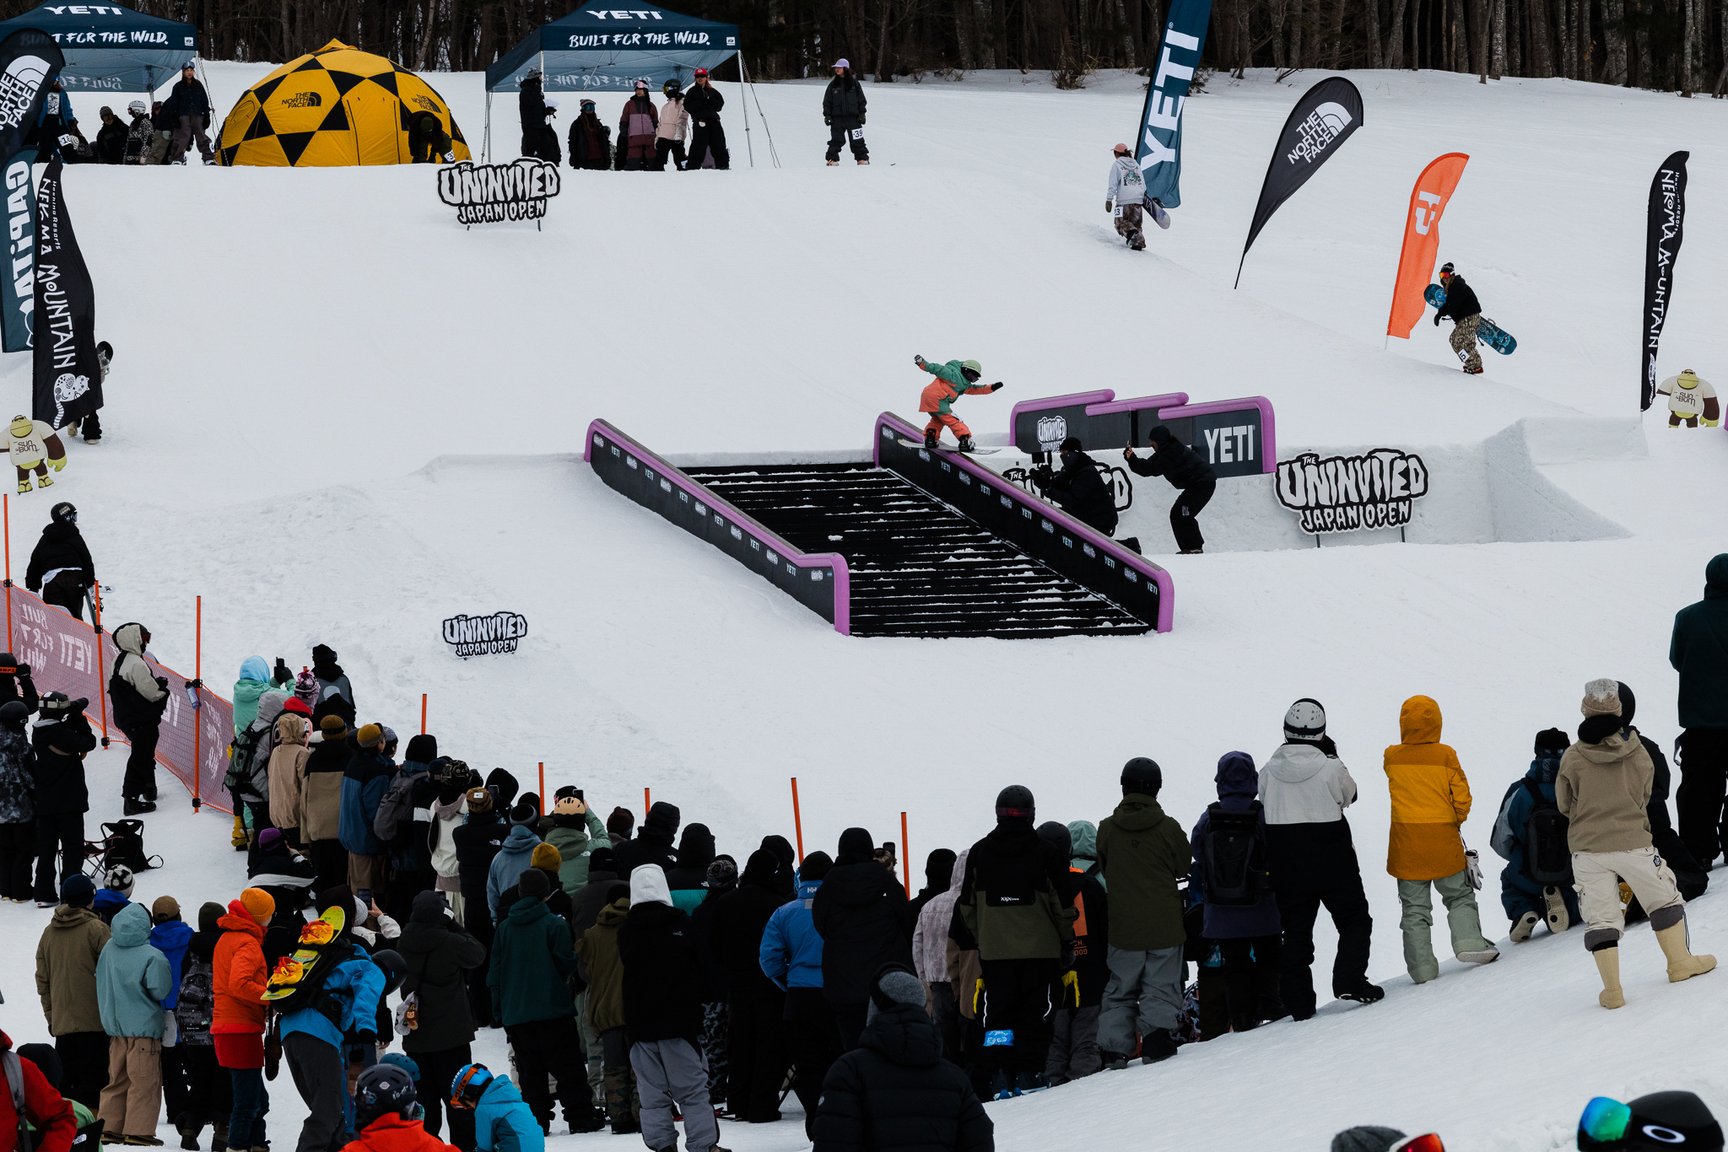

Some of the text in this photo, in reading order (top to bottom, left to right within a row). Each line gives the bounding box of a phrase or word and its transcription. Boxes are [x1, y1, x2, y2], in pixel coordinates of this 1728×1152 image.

[44, 5, 122, 15] YETI
[586, 10, 663, 20] YETI
[99, 32, 128, 43] THE
[569, 33, 607, 48] BUILT
[644, 32, 671, 44] THE
[0, 73, 15, 105] HE
[0, 80, 26, 130] ORTH
[1141, 28, 1199, 171] YETI
[8, 86, 37, 128] FACE
[1296, 110, 1323, 137] THE
[1287, 122, 1328, 165] NORTH
[1304, 131, 1334, 163] FACE
[438, 158, 561, 206] UNINVITED
[457, 197, 547, 224] JAPAN OPEN
[36, 264, 76, 370] MOUNTAIN
[1203, 424, 1256, 464] YETI
[1008, 469, 1024, 481] THE
[1301, 455, 1317, 466] THE
[1275, 447, 1429, 511] UNINVITED
[1301, 499, 1412, 532] JAPAN OPEN
[442, 611, 528, 645] UNINVITED
[456, 639, 518, 657] JAPAN OPEN
